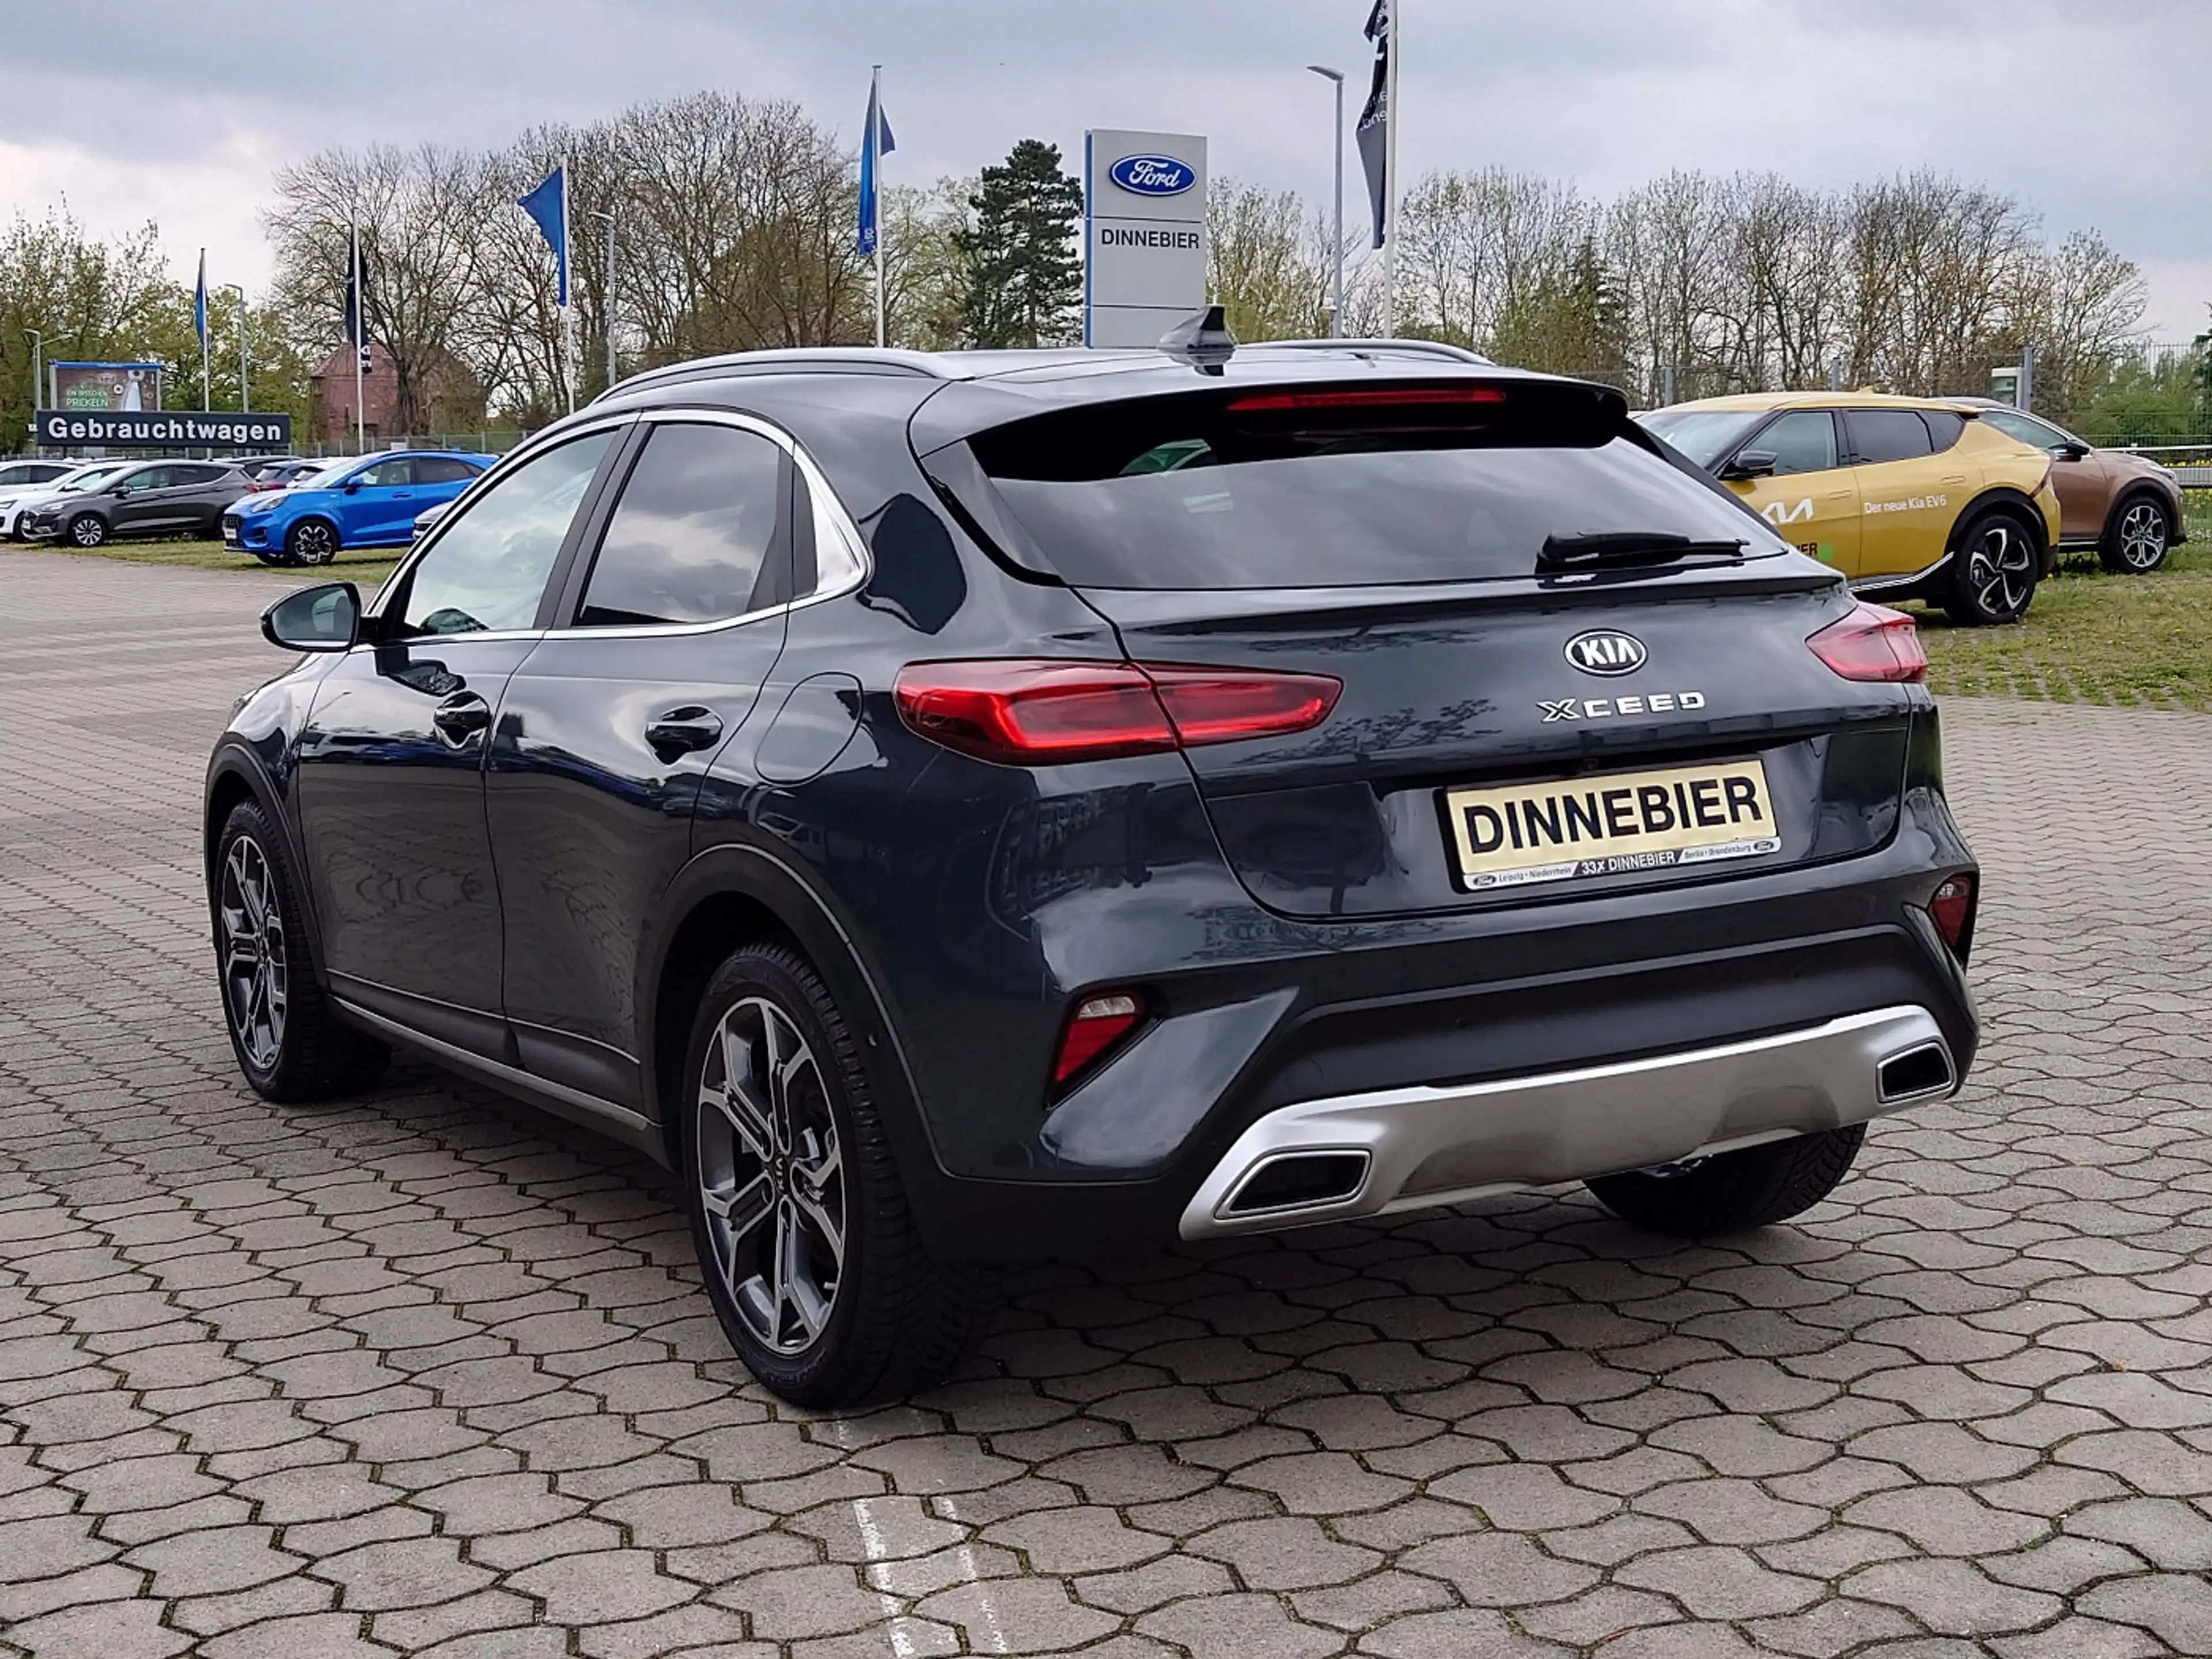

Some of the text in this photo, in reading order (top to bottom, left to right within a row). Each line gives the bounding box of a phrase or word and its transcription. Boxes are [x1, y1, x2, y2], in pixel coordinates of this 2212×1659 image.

[1128, 159, 1181, 188] Ford
[1101, 228, 1200, 249] DINNEBIER
[48, 416, 282, 444] Gebrauchtwagen
[1863, 494, 1948, 514] Der neue Kia EV6
[1577, 638, 1638, 666] KIA
[1536, 691, 1706, 723] XCEED
[1463, 775, 1763, 855] DINNEBIER
[1581, 851, 1676, 874] 33X DINNEBIER
[1684, 844, 1752, 859] Berlin Brandenburg
[1499, 866, 1571, 882] Leipzig Niederrhein
